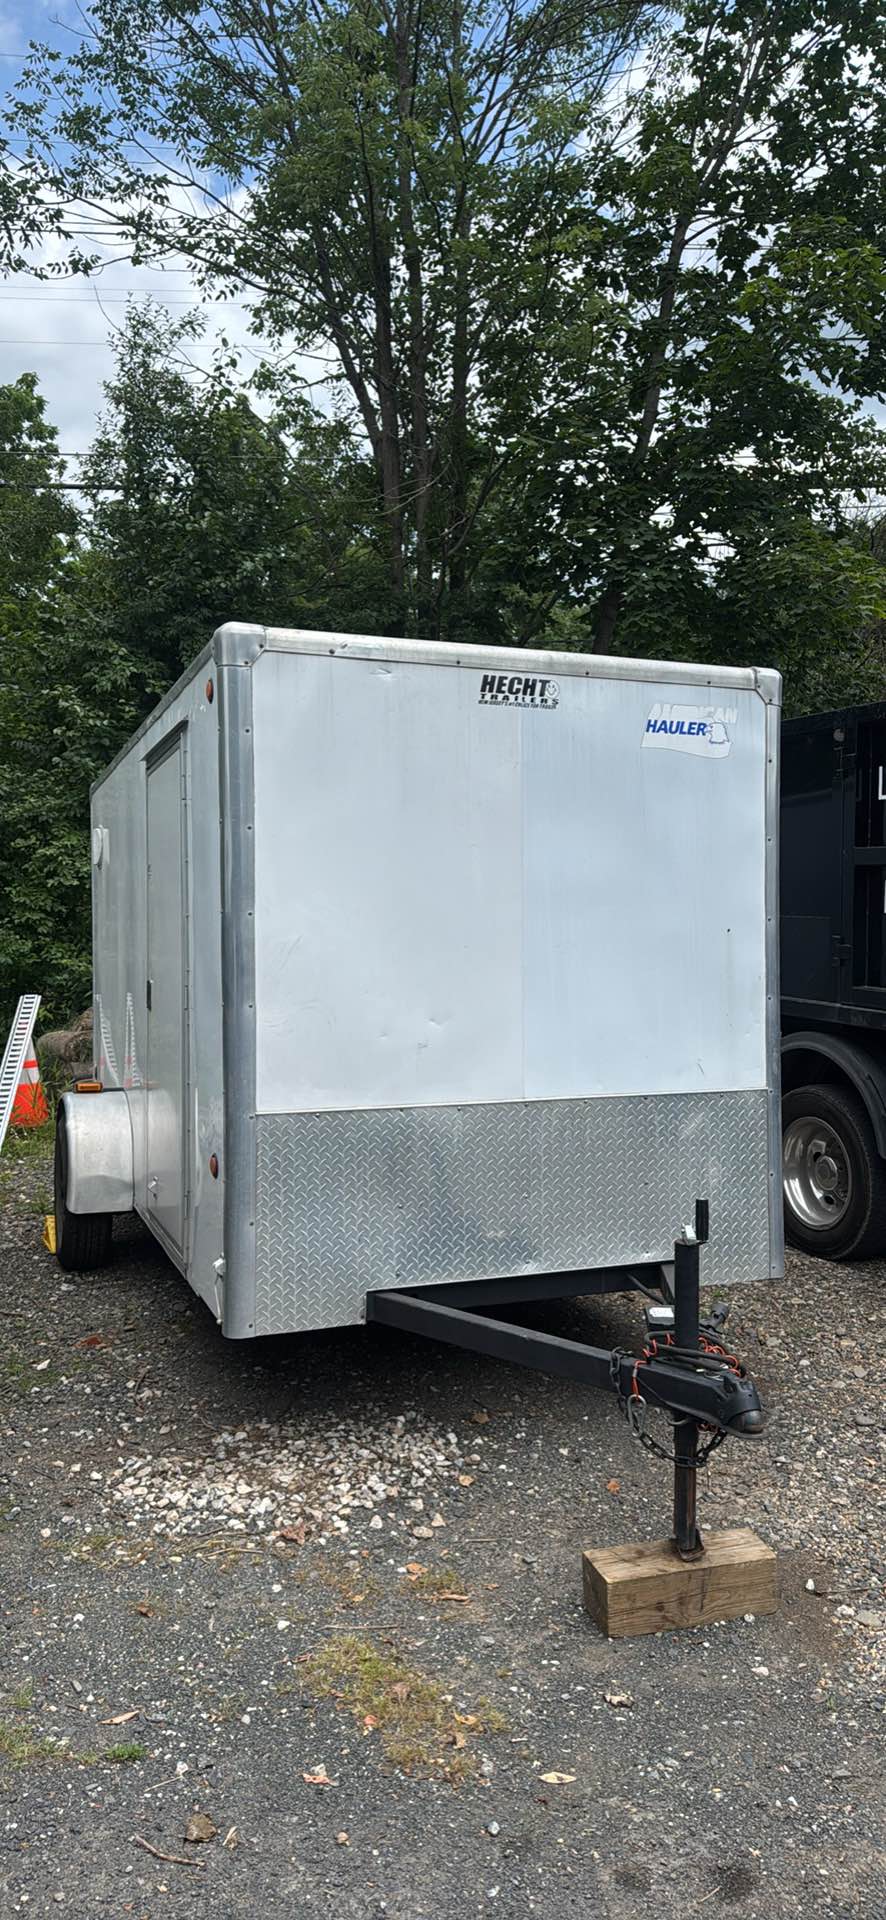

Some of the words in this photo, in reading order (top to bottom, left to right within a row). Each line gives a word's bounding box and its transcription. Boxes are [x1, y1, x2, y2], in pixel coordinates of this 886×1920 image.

[480, 675, 552, 697] HECHT
[480, 693, 559, 705] TRAILERS
[646, 719, 708, 736] HAULER
